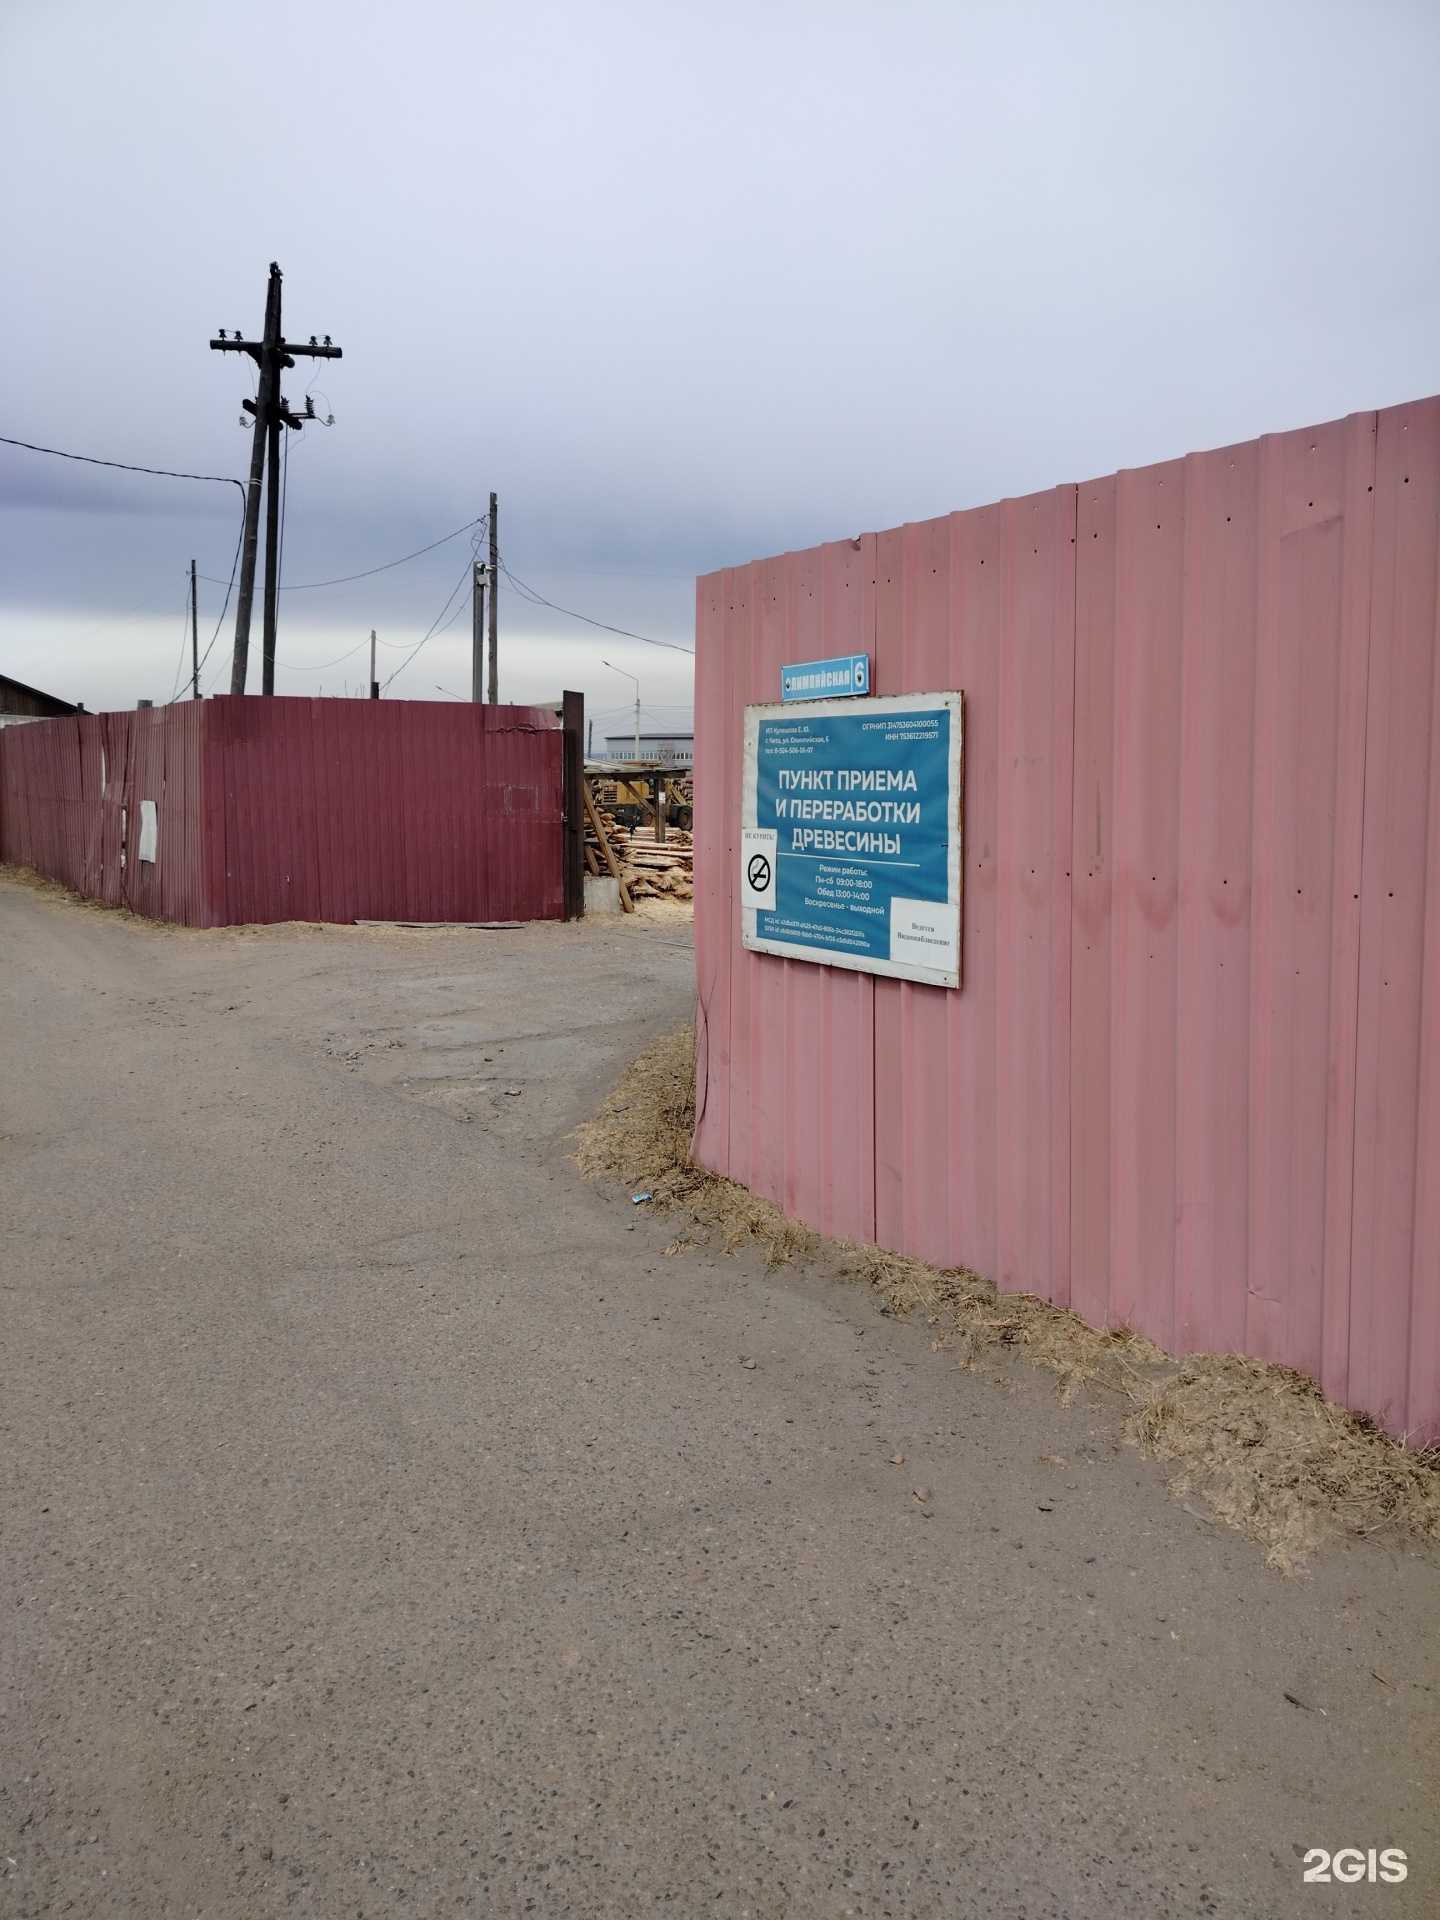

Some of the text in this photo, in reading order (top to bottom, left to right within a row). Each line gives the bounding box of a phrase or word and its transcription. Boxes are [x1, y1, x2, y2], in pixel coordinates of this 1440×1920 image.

[854, 662, 865, 687] 6
[778, 770, 918, 792] ПУНКТ ПРИЕМА
[775, 798, 921, 824] И ПЕРЕРАБОТКИ
[792, 828, 901, 854] ДРЕВЕСИНЫ
